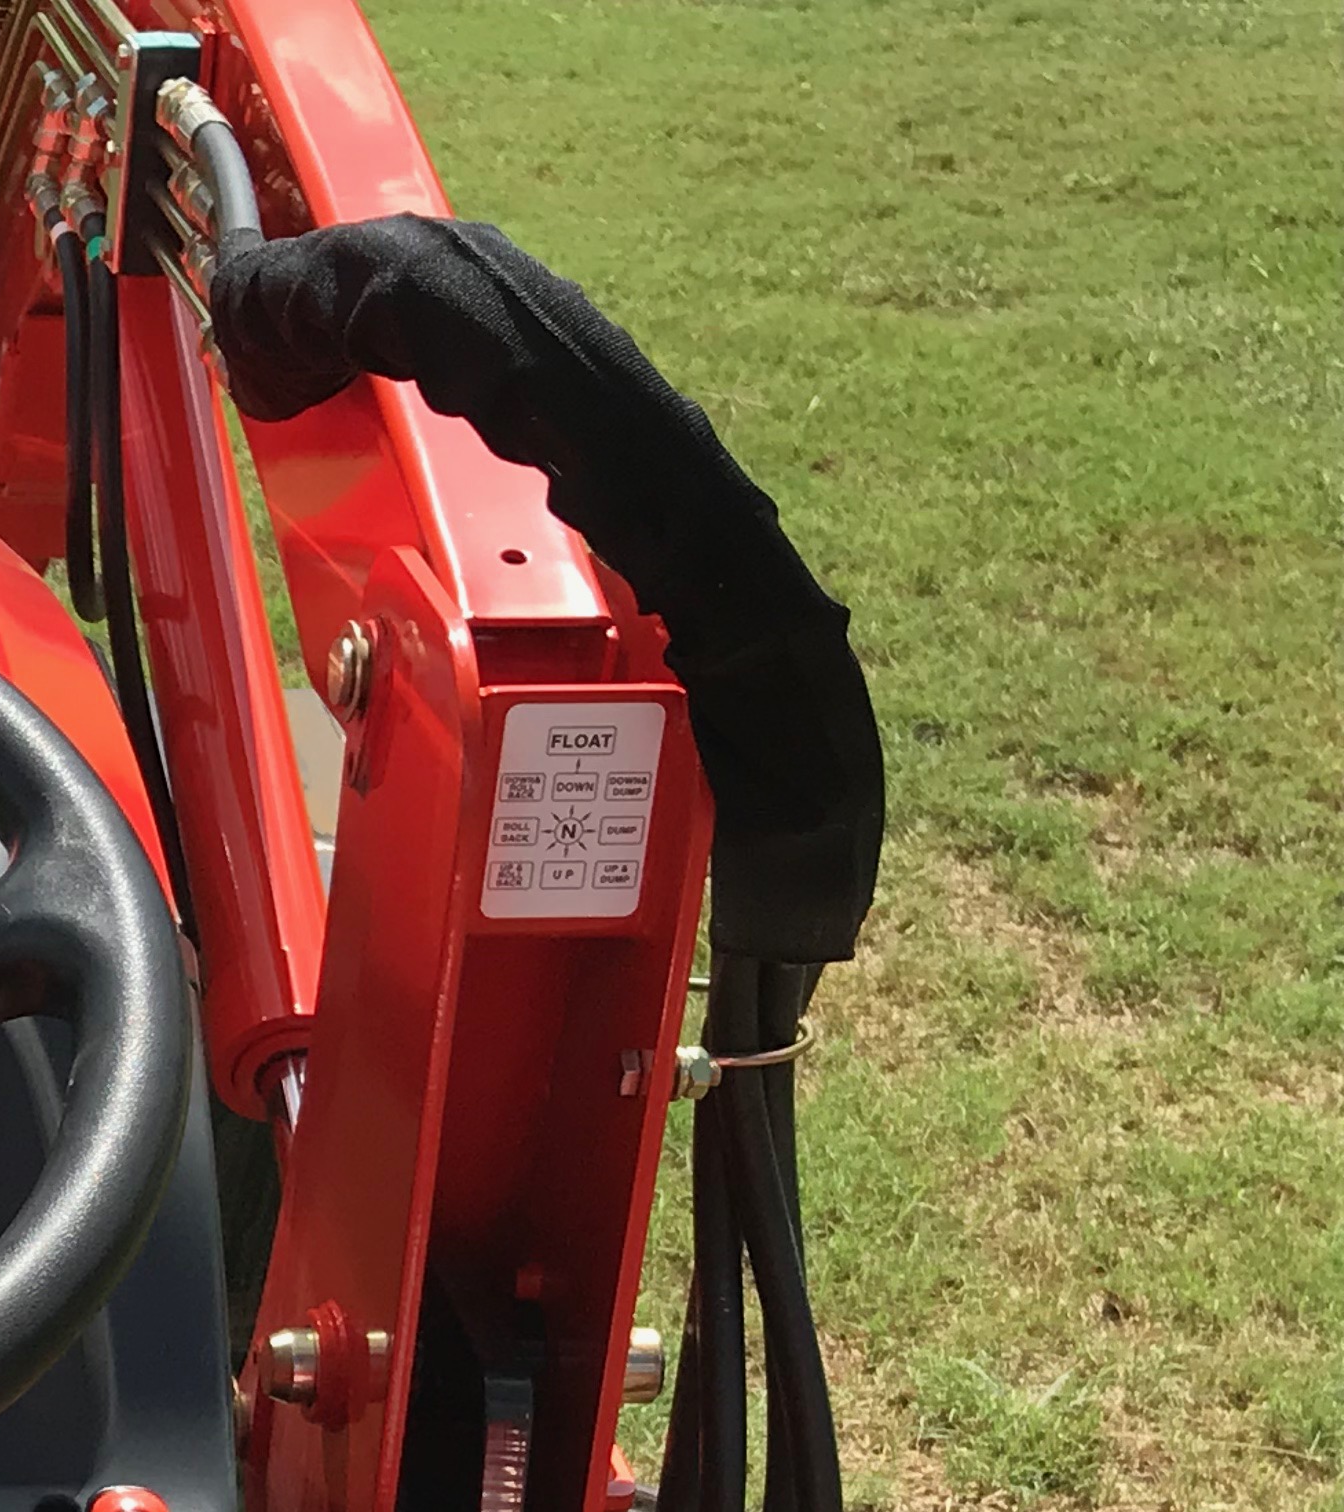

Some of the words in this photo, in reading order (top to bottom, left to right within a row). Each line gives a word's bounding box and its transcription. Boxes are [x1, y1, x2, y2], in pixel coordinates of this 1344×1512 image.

[550, 733, 613, 749] FLOAT
[556, 781, 595, 793] DOWN
[613, 788, 642, 796] DUMP
[502, 823, 530, 831] ROLL
[560, 823, 577, 840] N
[606, 826, 638, 835] DUMP
[501, 834, 529, 843] BACK
[604, 864, 620, 873] UP
[599, 874, 631, 884] DUMP
